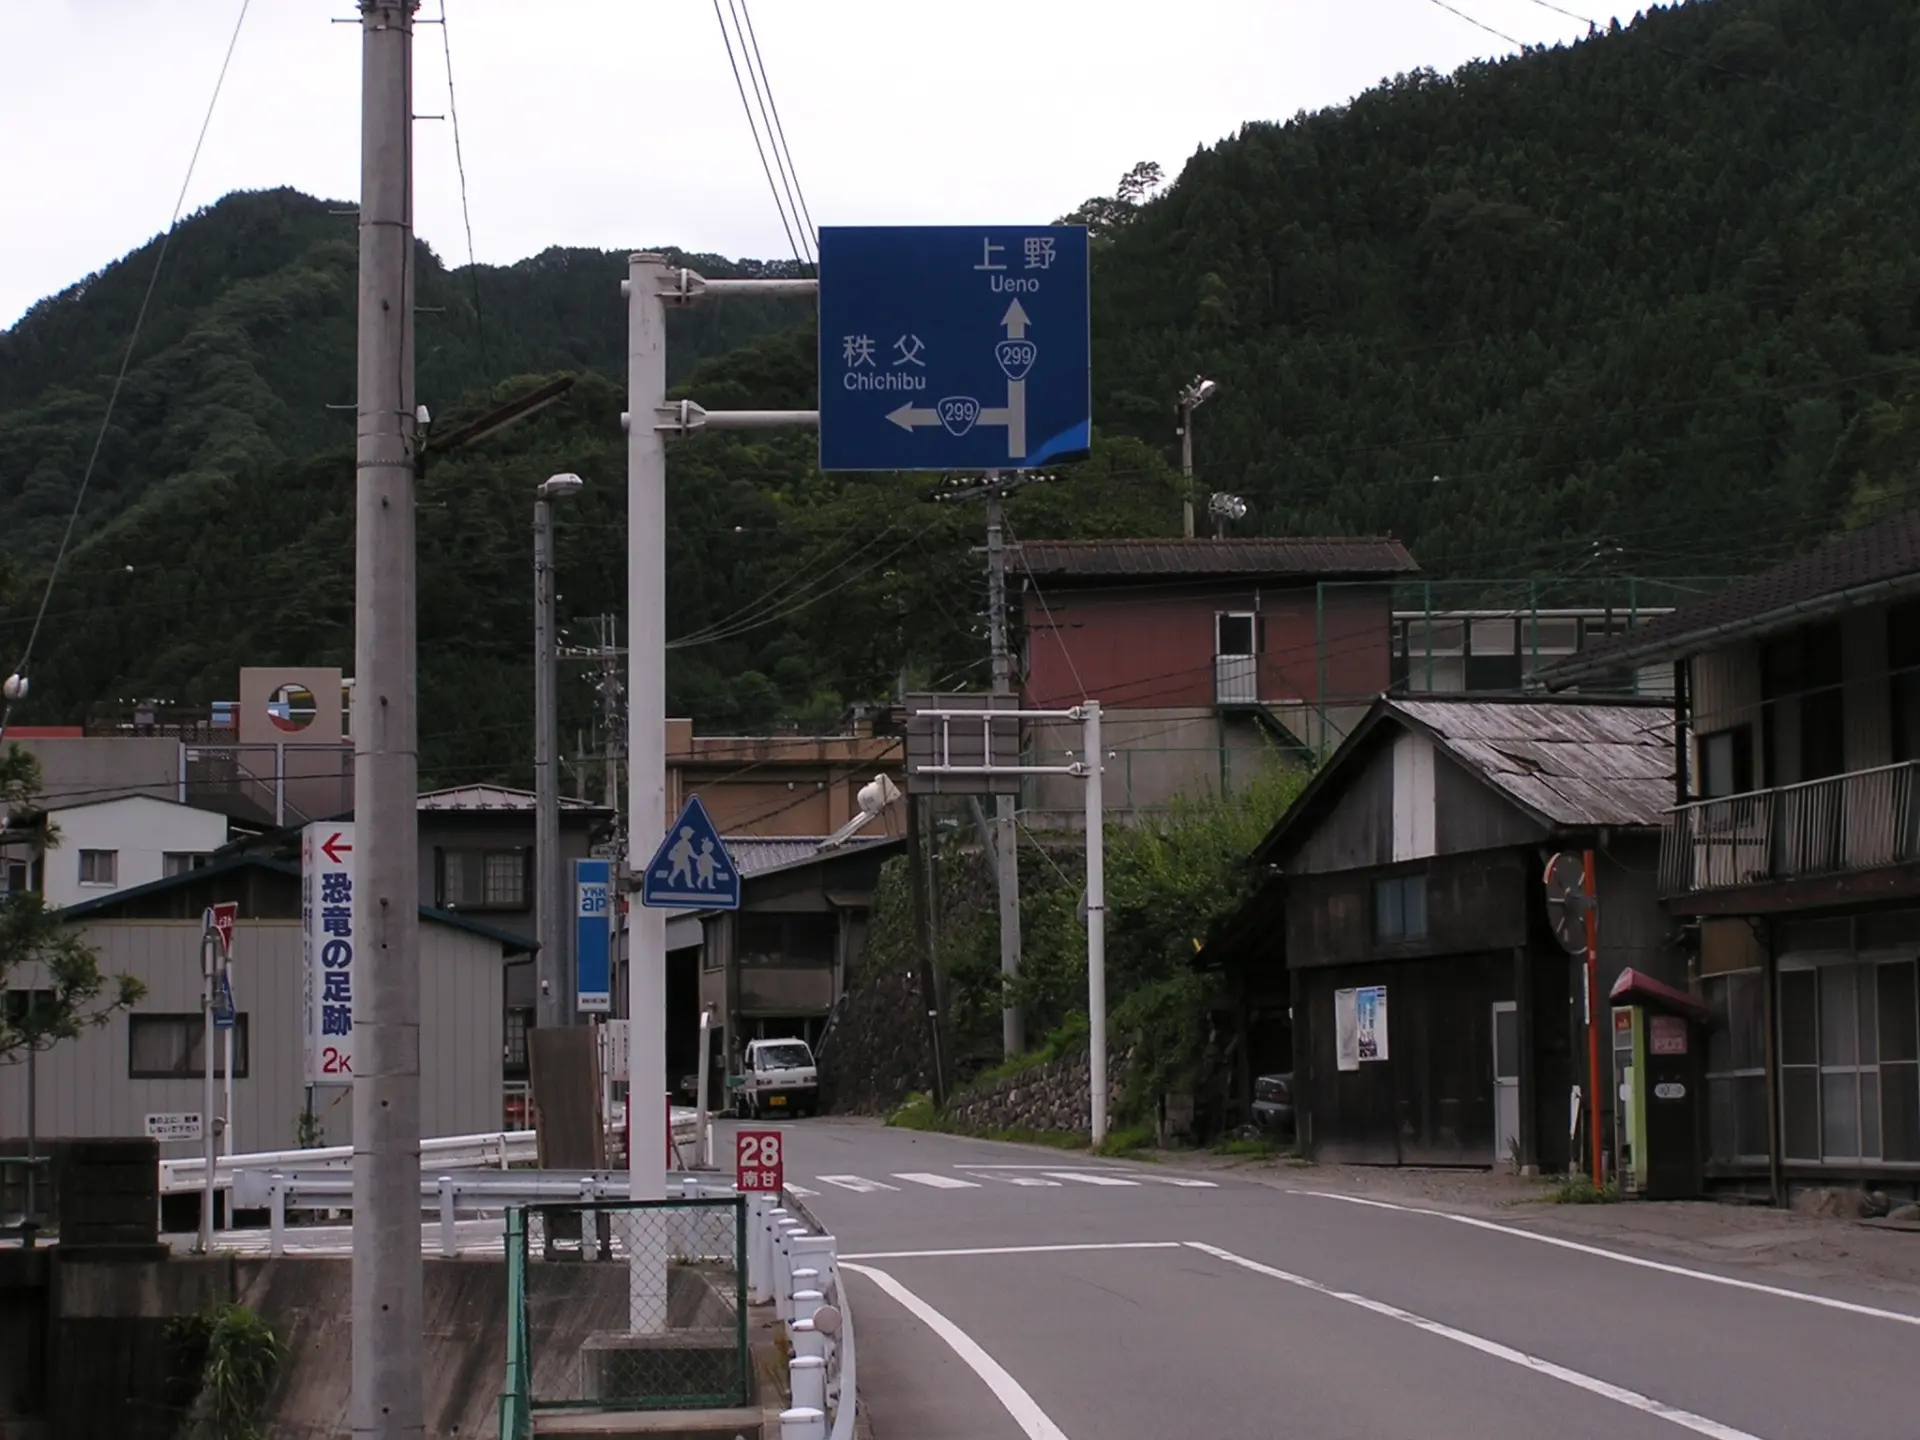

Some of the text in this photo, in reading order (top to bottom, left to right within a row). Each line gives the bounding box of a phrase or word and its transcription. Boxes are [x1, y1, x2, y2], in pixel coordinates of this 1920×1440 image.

[974, 237, 1057, 270] 上野
[990, 275, 1040, 293] Ueno
[843, 334, 926, 368] 秩父
[1002, 346, 1032, 365] 299
[843, 372, 926, 390] Chichibu
[945, 402, 974, 421] 299
[582, 898, 607, 912] ap
[321, 873, 353, 1036] 恐竜の足跡
[739, 1136, 779, 1167] 28
[743, 1171, 777, 1187] 南甘
